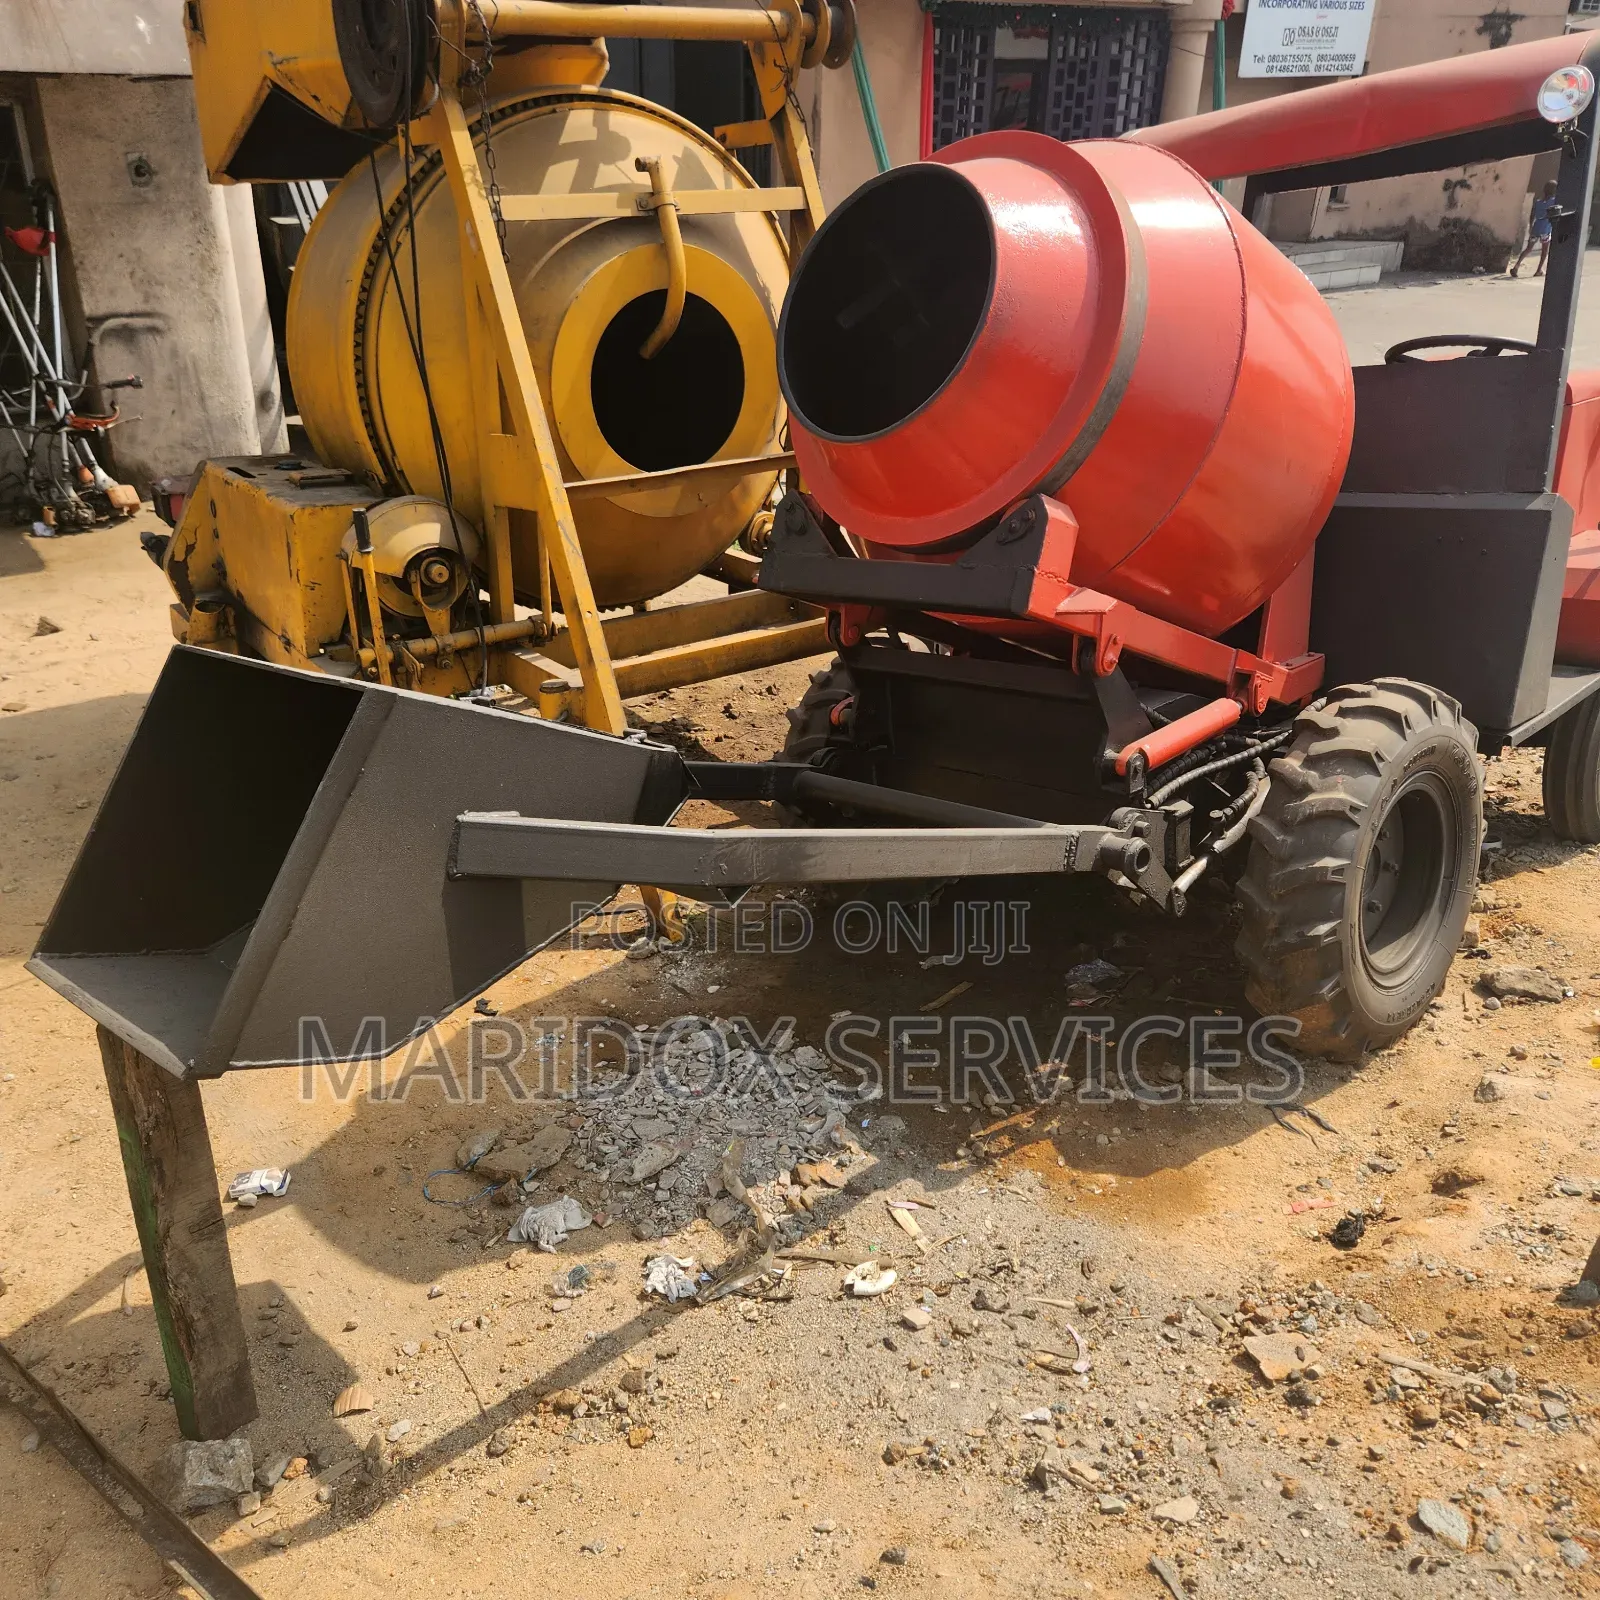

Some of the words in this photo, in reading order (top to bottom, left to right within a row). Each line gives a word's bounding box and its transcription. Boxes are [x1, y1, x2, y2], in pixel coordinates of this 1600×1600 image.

[1258, 0, 1317, 10] INCORPORATING
[1320, 0, 1347, 10] VARIOUS
[1348, 1, 1365, 11] SIZES
[1297, 26, 1314, 38] OSAS
[1253, 54, 1265, 63] Tel:
